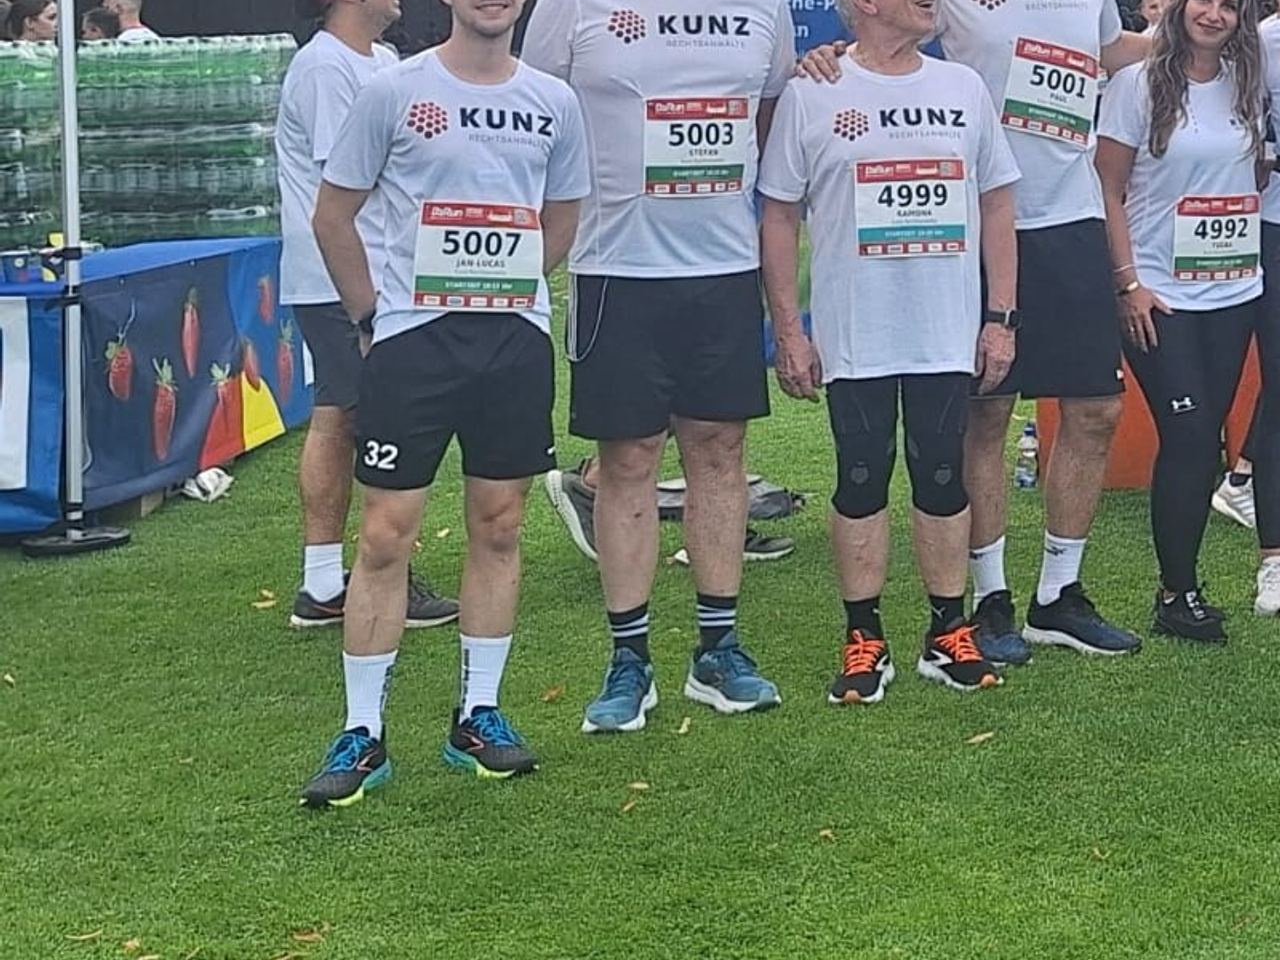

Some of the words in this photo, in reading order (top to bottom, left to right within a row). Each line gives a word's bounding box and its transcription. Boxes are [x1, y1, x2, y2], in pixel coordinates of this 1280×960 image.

[658, 15, 751, 36] KUNZ
[1030, 64, 1086, 98] 5001
[460, 107, 553, 137] KUNZ
[879, 108, 966, 128] KUNZ
[669, 122, 734, 146] 5003
[878, 183, 948, 207] 4999
[1194, 218, 1248, 239] 4992
[442, 230, 522, 256] 5007
[364, 441, 398, 470] 32
